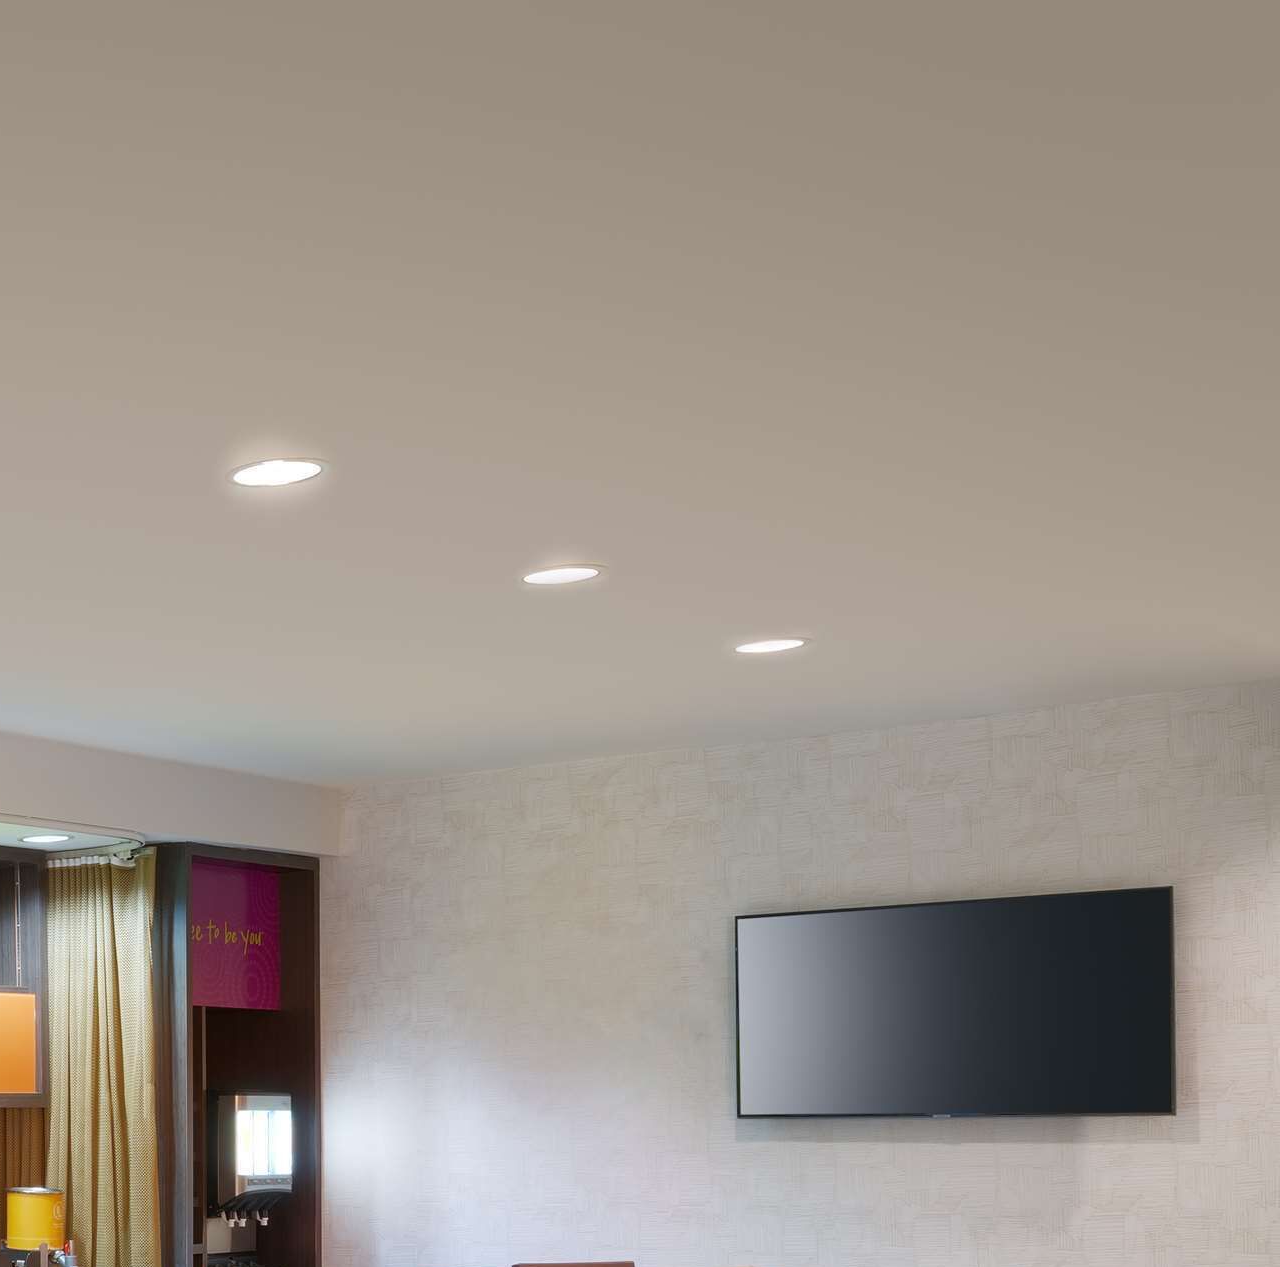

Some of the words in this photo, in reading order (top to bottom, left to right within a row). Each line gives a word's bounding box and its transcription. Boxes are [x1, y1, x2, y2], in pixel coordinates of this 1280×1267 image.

[207, 919, 220, 944] to
[224, 921, 238, 945] be
[240, 929, 263, 956] you
